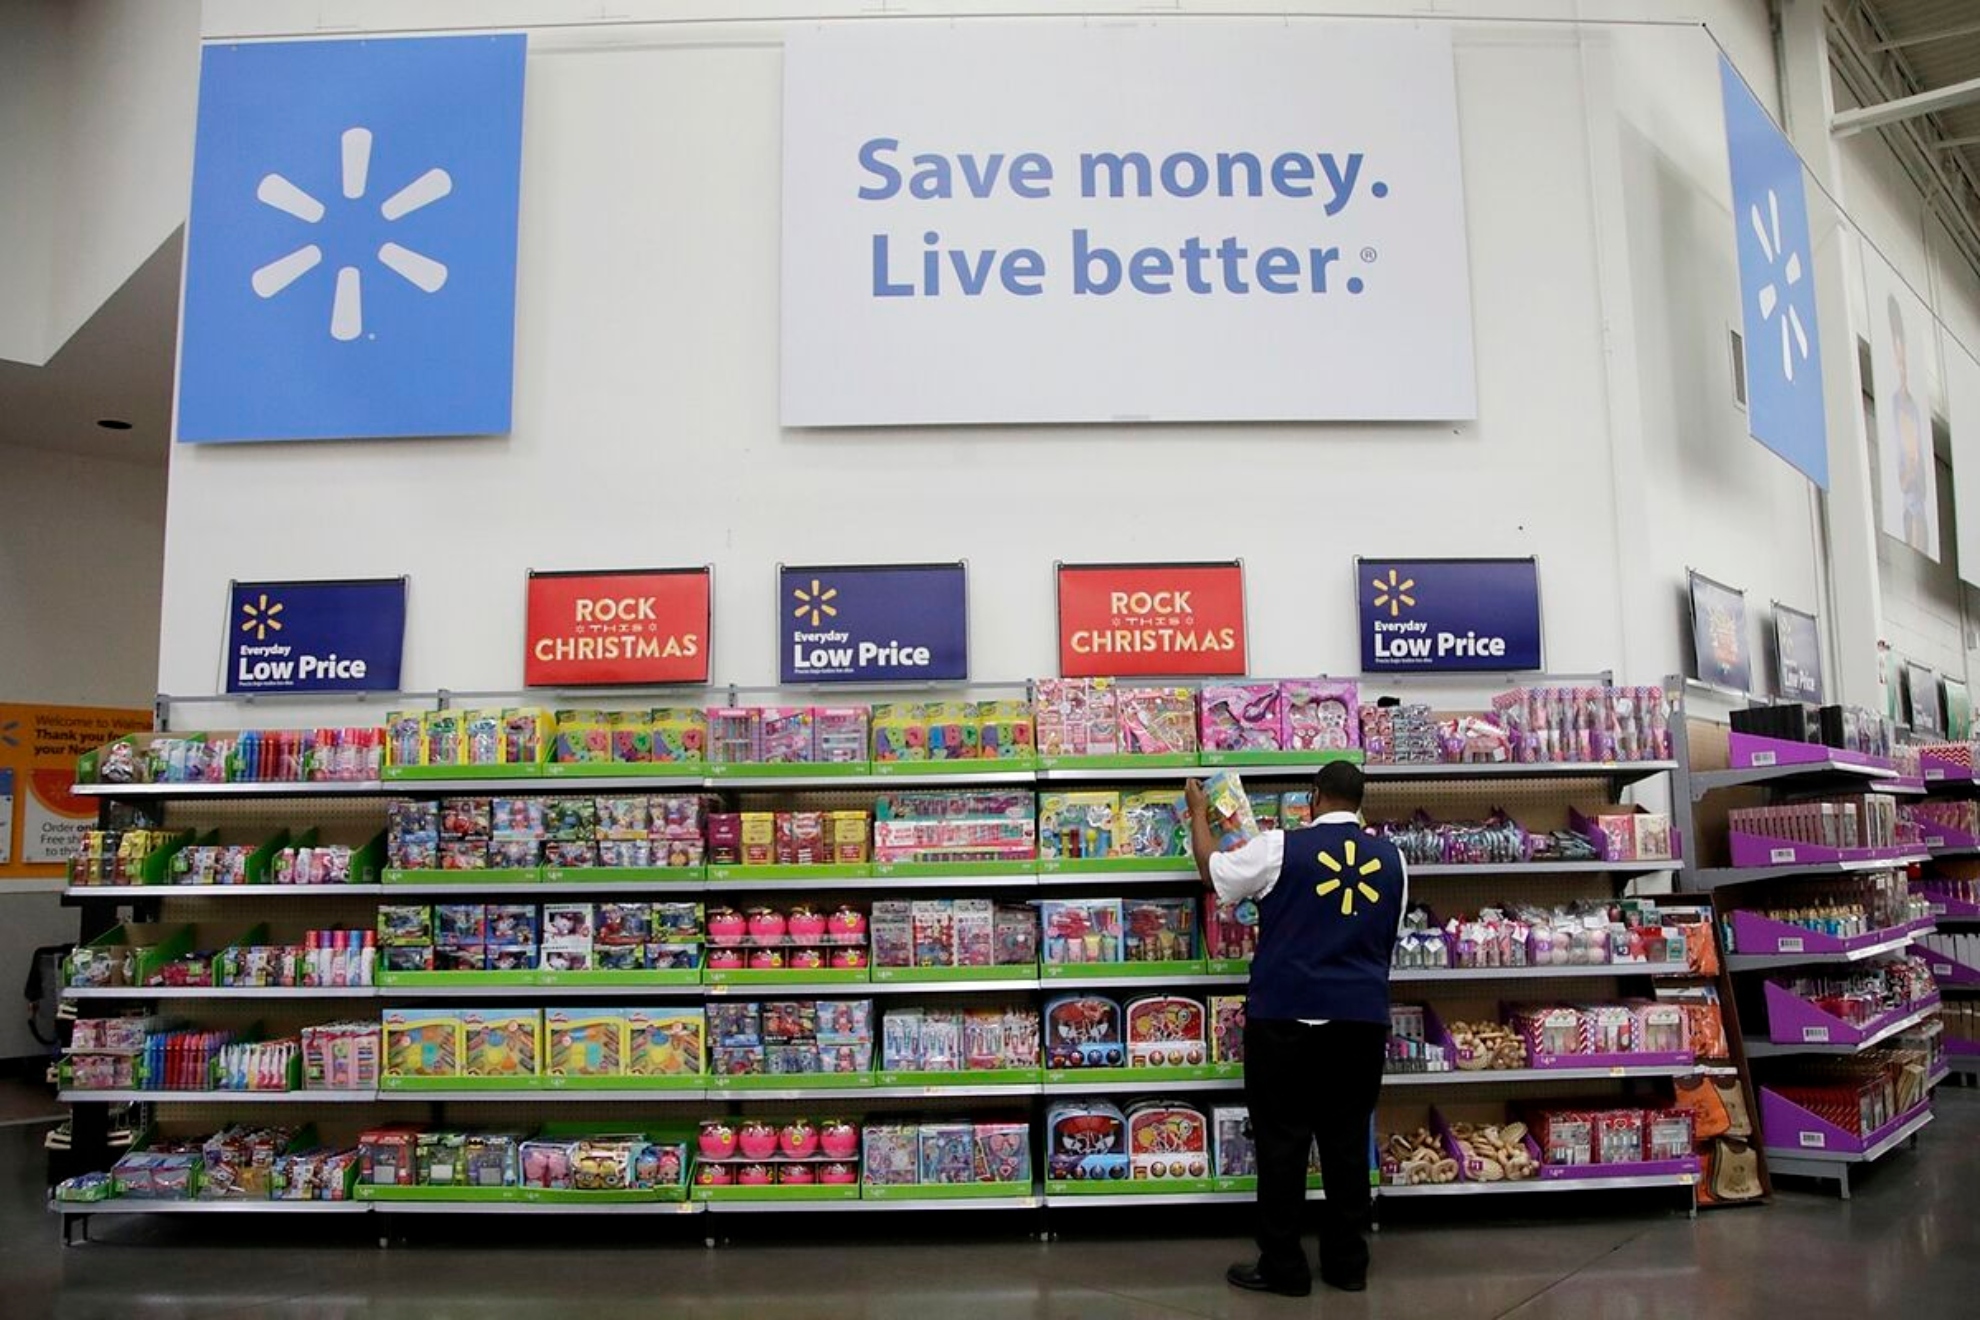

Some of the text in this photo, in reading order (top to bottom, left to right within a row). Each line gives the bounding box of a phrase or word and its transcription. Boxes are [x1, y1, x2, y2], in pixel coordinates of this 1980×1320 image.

[857, 138, 1388, 217] Save money.
[872, 230, 1046, 297] Live
[575, 597, 657, 622] ROCK
[1110, 591, 1192, 615] ROCK
[589, 624, 643, 633] THIS
[1125, 617, 1181, 626] THIS
[1374, 620, 1428, 633] Everyday
[794, 630, 849, 643] Everyday
[1070, 628, 1236, 653] CHRISTMAS
[1374, 631, 1506, 658] Low Price
[240, 643, 292, 657] Everyday
[535, 633, 699, 661] CHRISTMAS
[794, 640, 930, 668] Low Price
[238, 653, 367, 681] Low Price
[36, 729, 77, 741] Thank
[80, 733, 105, 743] you
[34, 746, 65, 756] your
[42, 821, 74, 833] Order
[41, 834, 65, 844] Free
